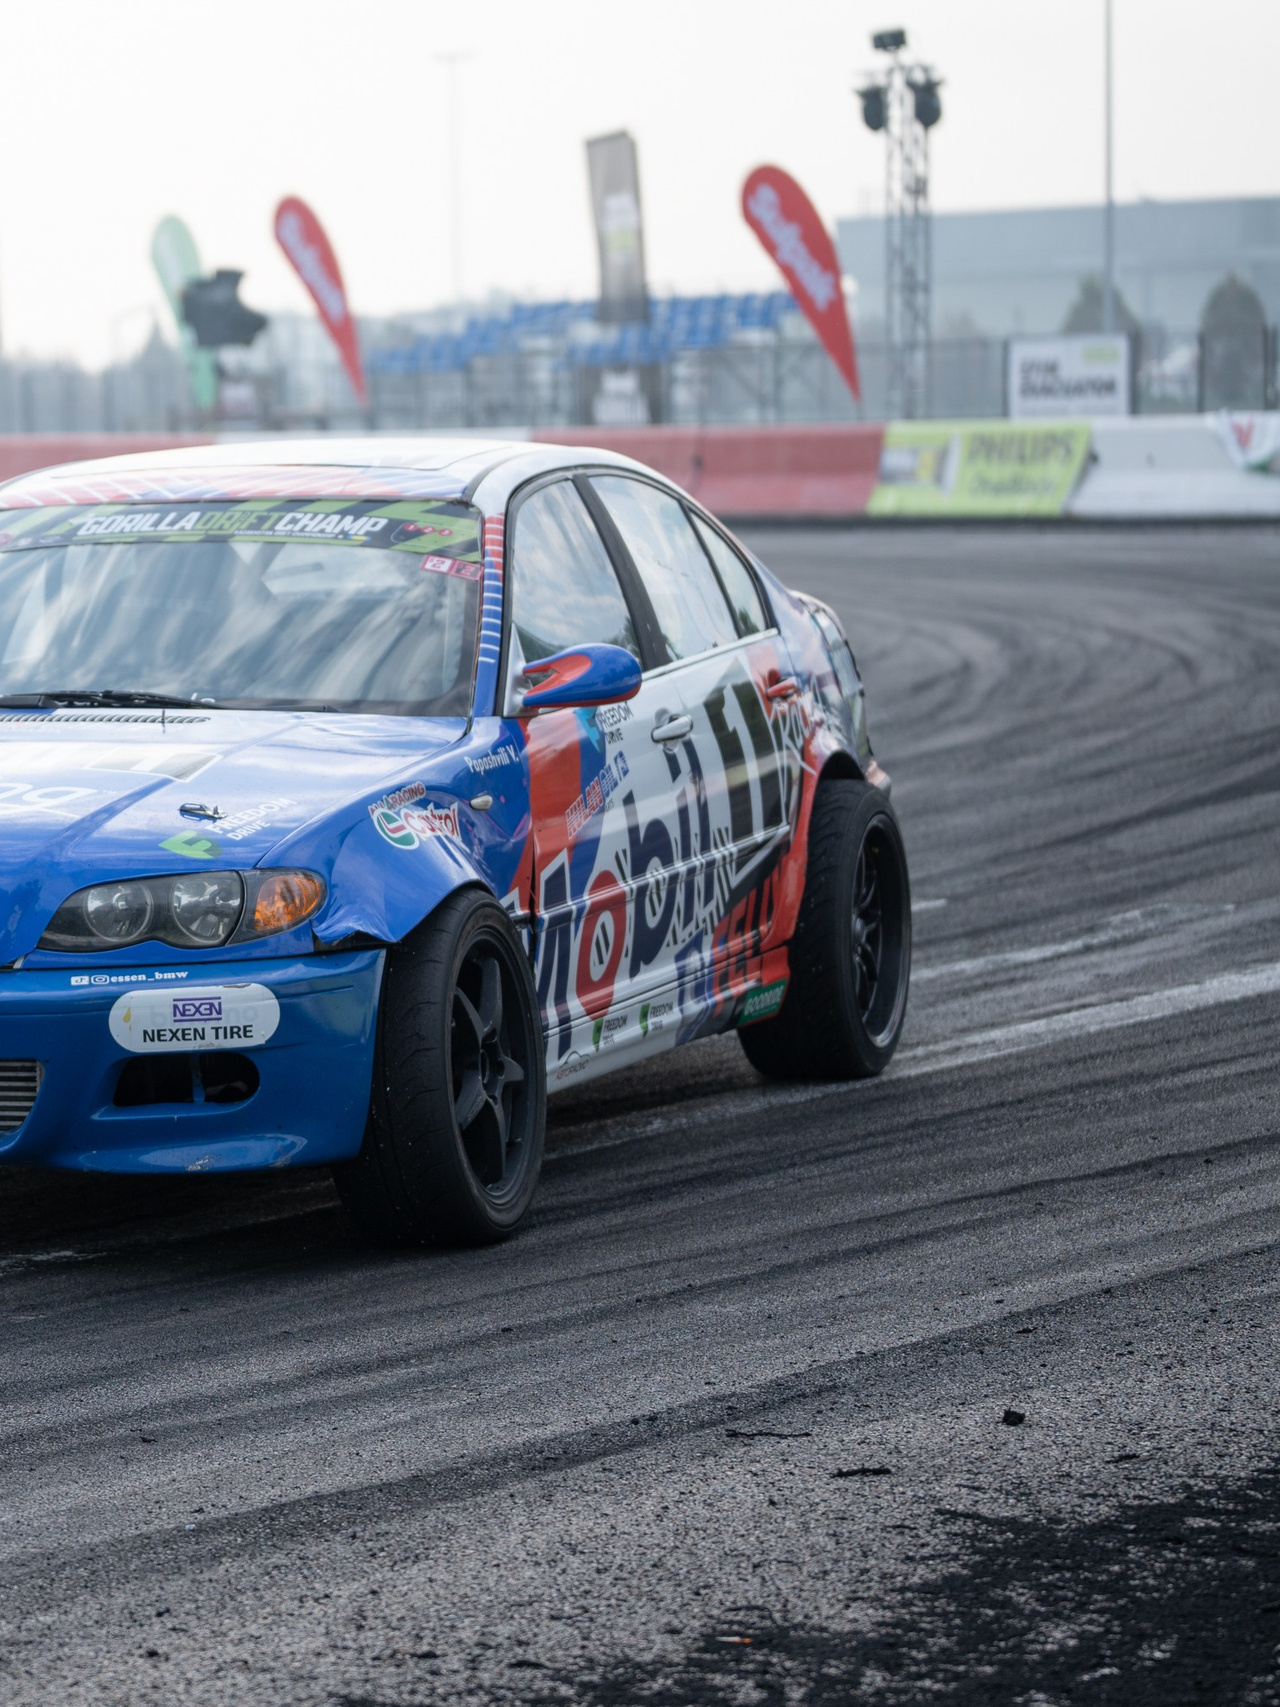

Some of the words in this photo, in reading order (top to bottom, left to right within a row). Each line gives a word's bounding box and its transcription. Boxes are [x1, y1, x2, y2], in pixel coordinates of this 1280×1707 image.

[969, 431, 1073, 463] PHILIPS
[204, 798, 298, 834] FREEDOM
[226, 820, 271, 841] DRIVE
[111, 971, 188, 983] essen_bmw
[173, 1001, 222, 1018] NEXEN
[650, 1003, 674, 1019] FREEDOM
[603, 1015, 628, 1031] FREEDOM
[143, 1027, 206, 1043] NEXEN
[211, 1024, 254, 1040] TIRE
